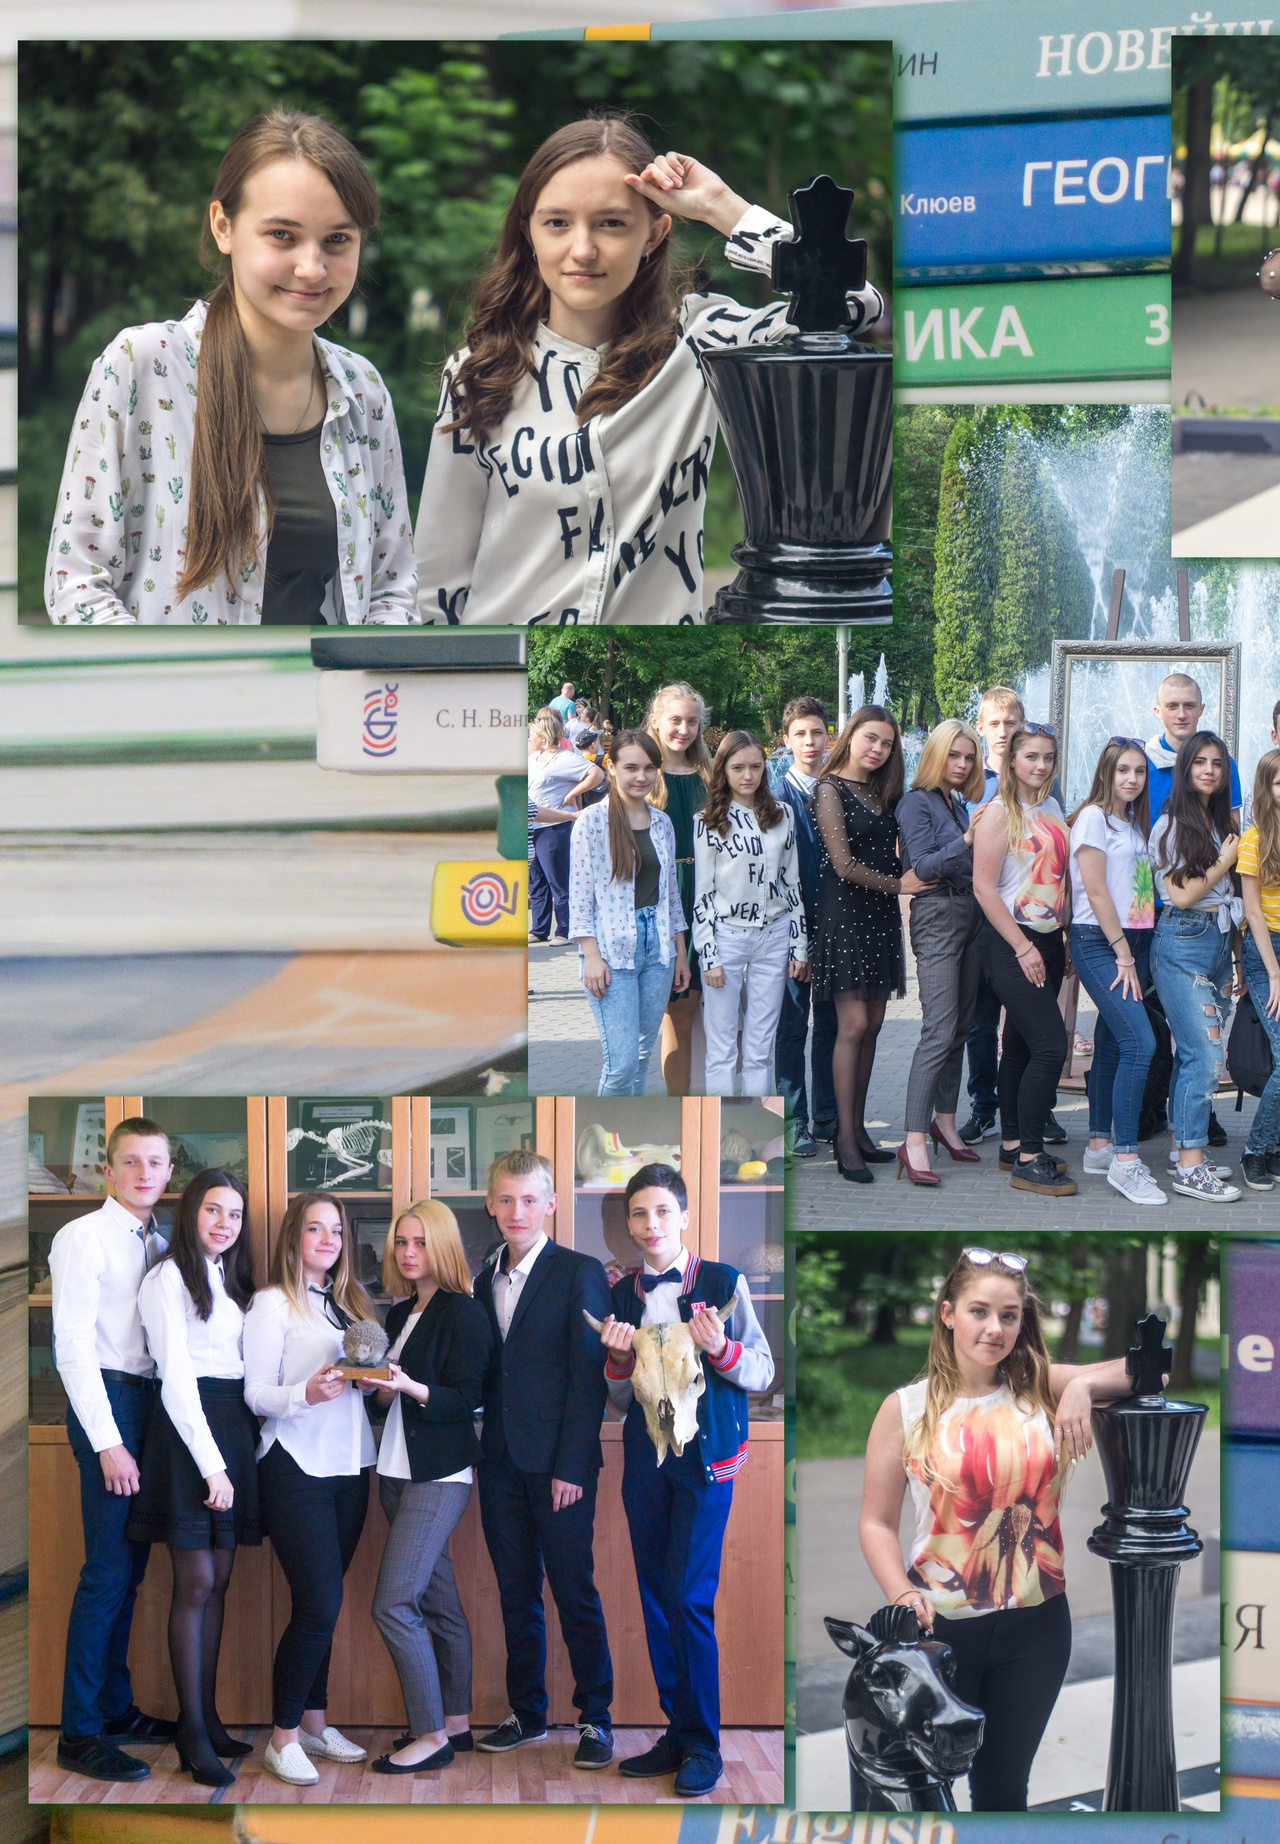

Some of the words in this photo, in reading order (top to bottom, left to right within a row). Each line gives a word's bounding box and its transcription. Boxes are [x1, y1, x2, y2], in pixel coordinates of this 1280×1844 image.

[1022, 155, 1171, 207] ГЕОГ
[900, 194, 977, 215] Клюев
[900, 305, 1034, 361] ИКА
[436, 708, 455, 728] С.
[462, 708, 482, 728] Н.
[716, 1803, 956, 1844] English
